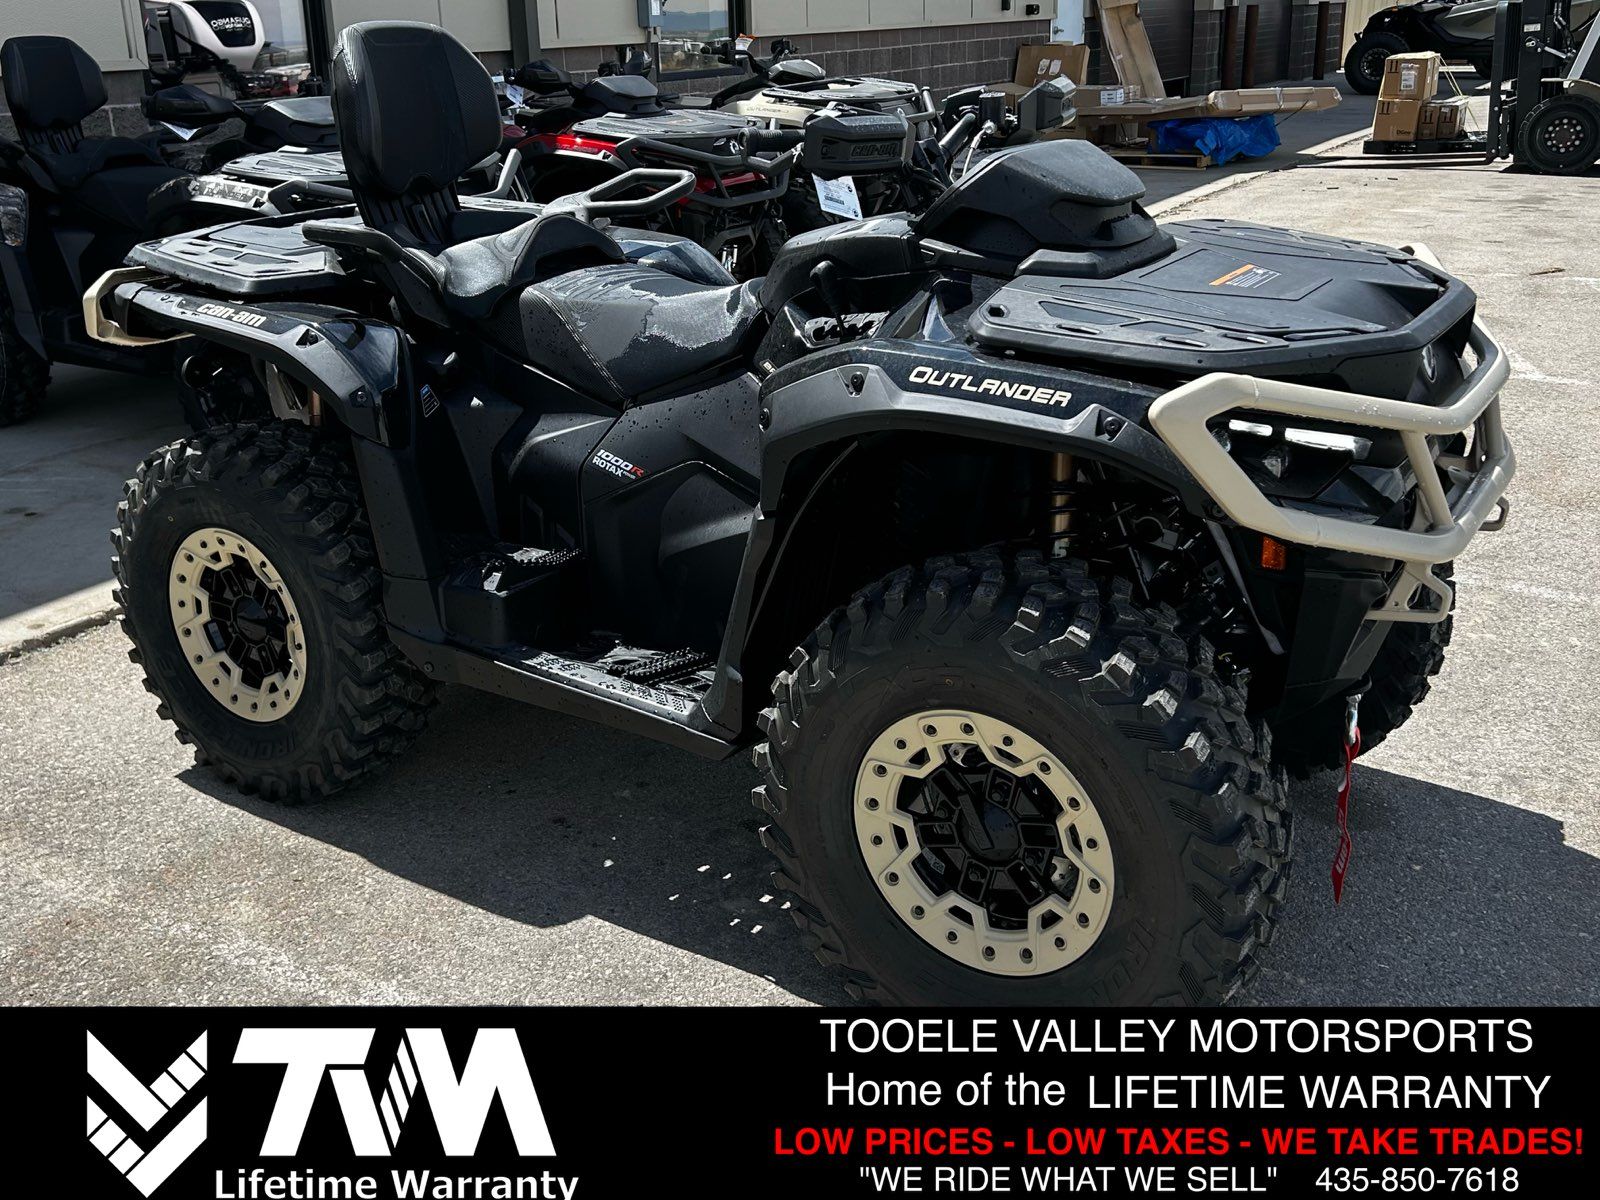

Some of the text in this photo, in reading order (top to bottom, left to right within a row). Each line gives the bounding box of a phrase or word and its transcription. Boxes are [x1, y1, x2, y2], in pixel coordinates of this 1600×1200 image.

[196, 303, 267, 327] can-am
[908, 365, 1073, 408] OUTLANDER
[592, 455, 624, 478] ROTAX
[596, 449, 645, 477] 1000R
